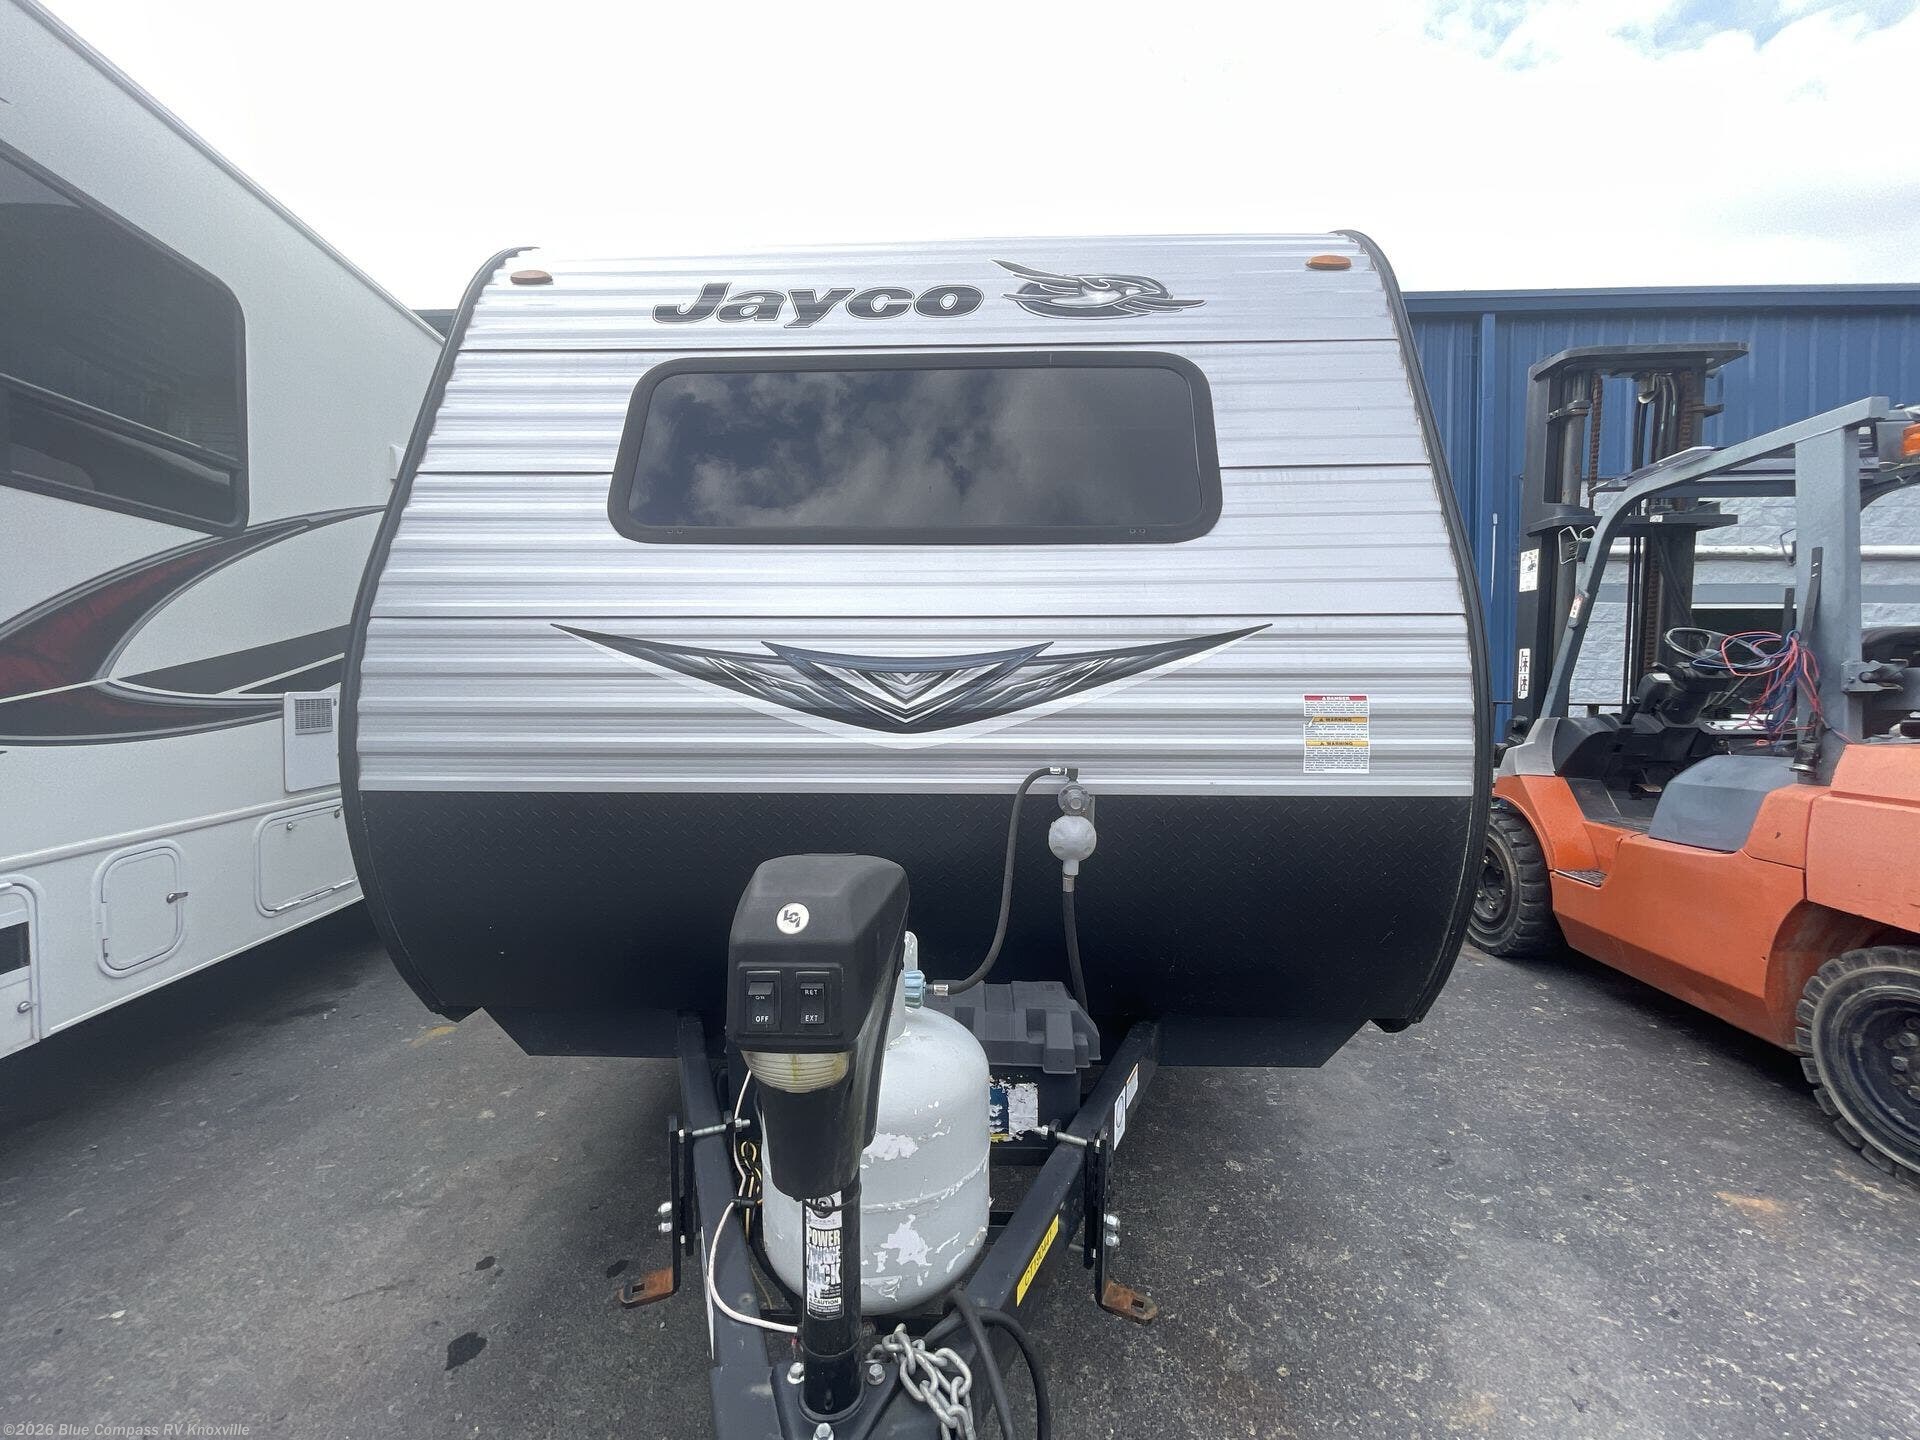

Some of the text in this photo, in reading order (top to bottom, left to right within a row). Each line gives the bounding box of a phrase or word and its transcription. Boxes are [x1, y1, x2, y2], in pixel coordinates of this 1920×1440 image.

[652, 282, 984, 328] Jayco
[755, 1015, 769, 1023] OFF
[807, 1228, 841, 1247] POWER
[813, 1297, 839, 1306] CAUTION
